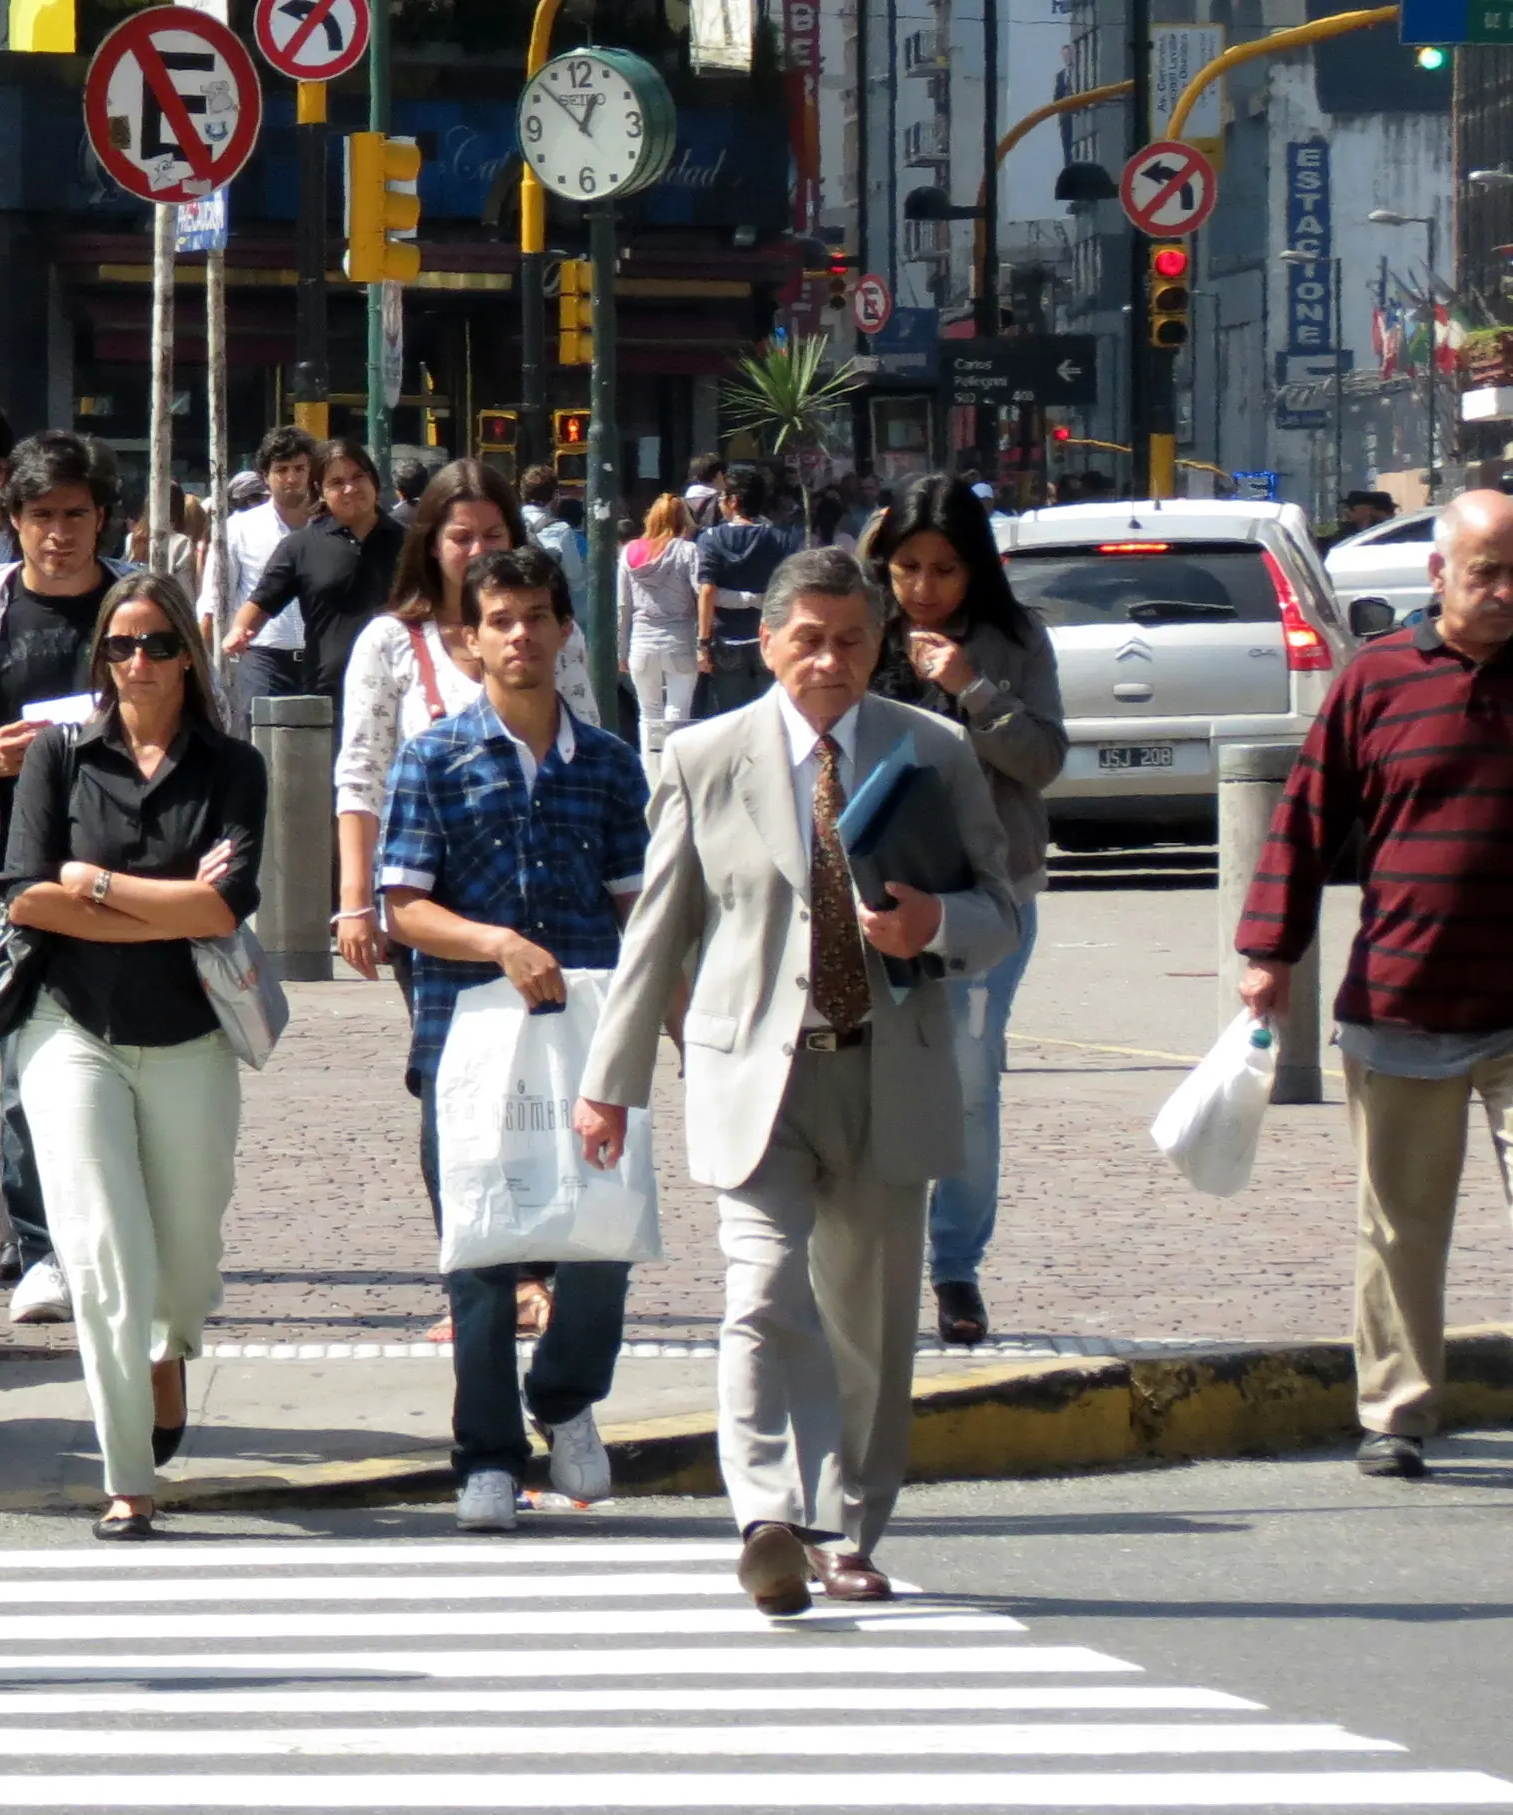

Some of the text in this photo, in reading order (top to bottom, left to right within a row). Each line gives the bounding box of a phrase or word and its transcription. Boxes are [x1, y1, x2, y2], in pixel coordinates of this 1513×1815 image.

[567, 61, 593, 89] 12
[526, 116, 543, 143] 9
[625, 111, 643, 138] 3
[579, 167, 596, 193] 6
